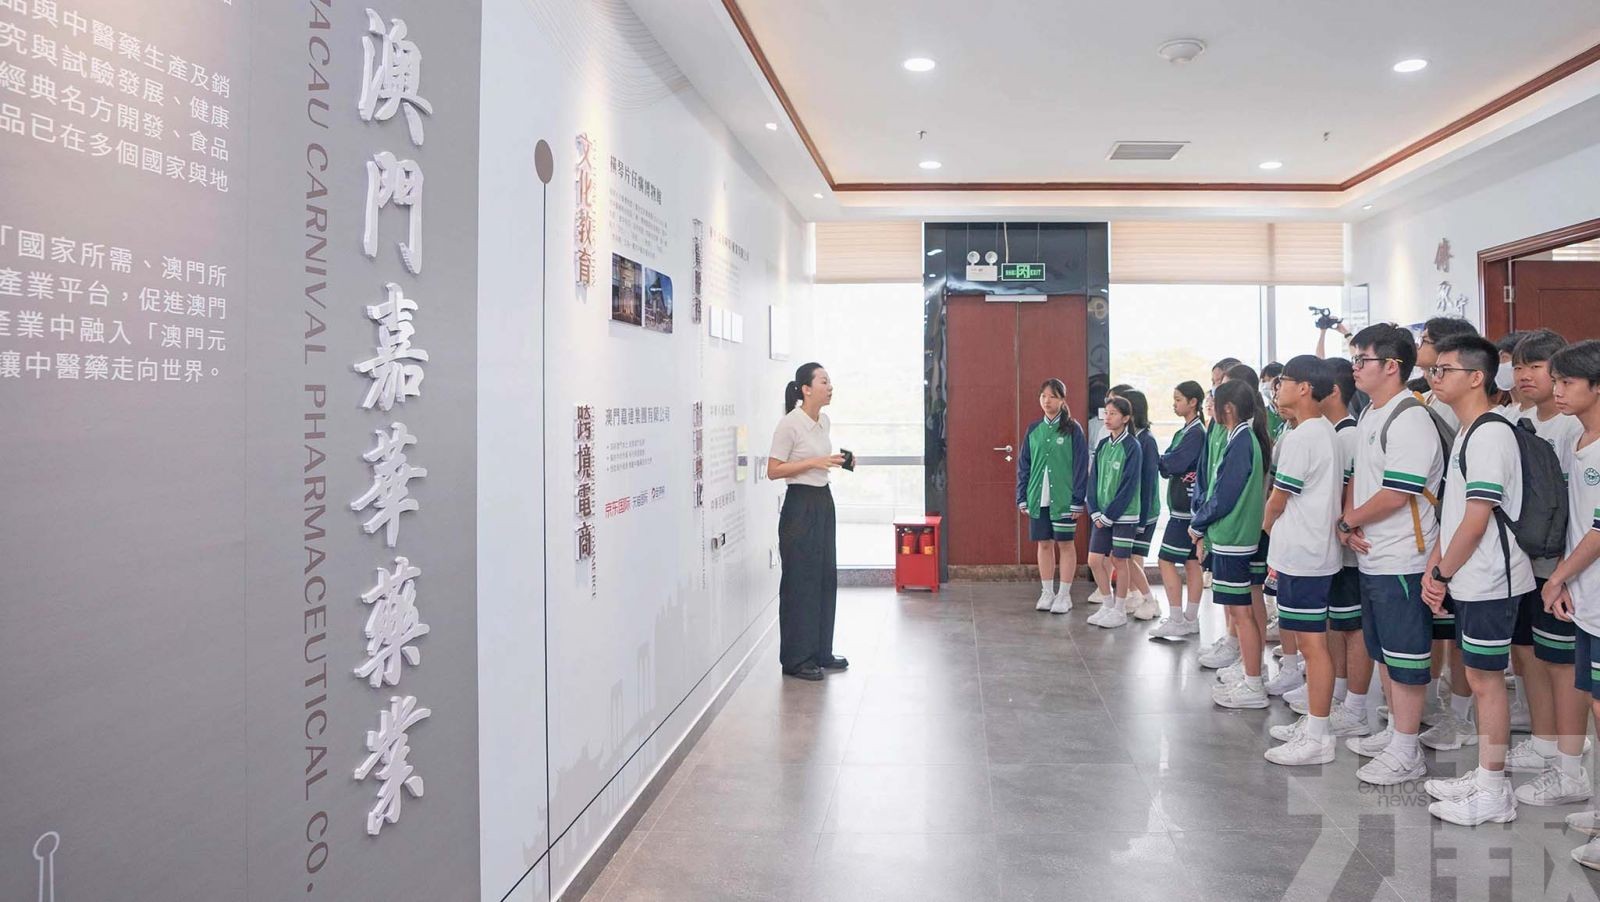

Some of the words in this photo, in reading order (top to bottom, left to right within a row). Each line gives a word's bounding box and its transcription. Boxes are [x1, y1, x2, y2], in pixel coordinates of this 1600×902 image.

[0, 21, 230, 130] 究與試驗發展、健康
[0, 61, 229, 161] 經典名方開發、食品
[307, 0, 331, 129] ACAU
[0, 103, 229, 193] 品已在多個國家與地
[576, 132, 592, 287] 文化教育
[303, 142, 330, 365] CARNIVAL
[576, 404, 592, 560] 跨境電商
[303, 384, 328, 800] PHARMACEUTICAL
[306, 811, 329, 893] CO.
